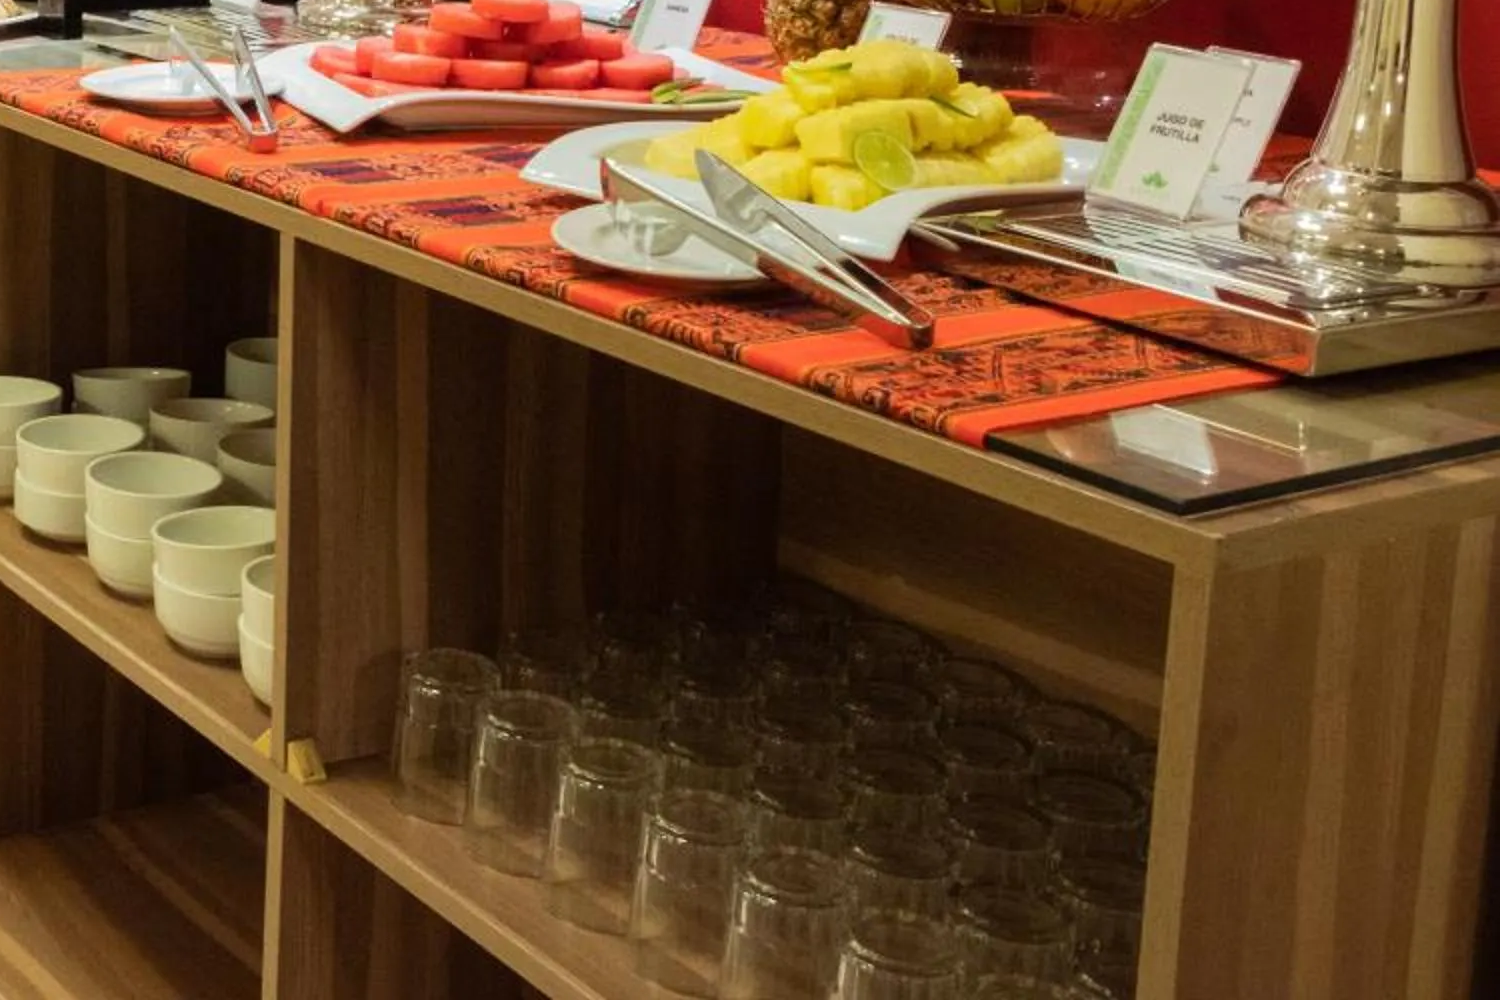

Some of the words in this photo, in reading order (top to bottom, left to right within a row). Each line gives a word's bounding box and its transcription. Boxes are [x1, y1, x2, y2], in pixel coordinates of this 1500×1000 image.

[1156, 112, 1188, 125] JUGO
[1188, 117, 1206, 129] DE
[1150, 124, 1199, 144] FRUTILLA
